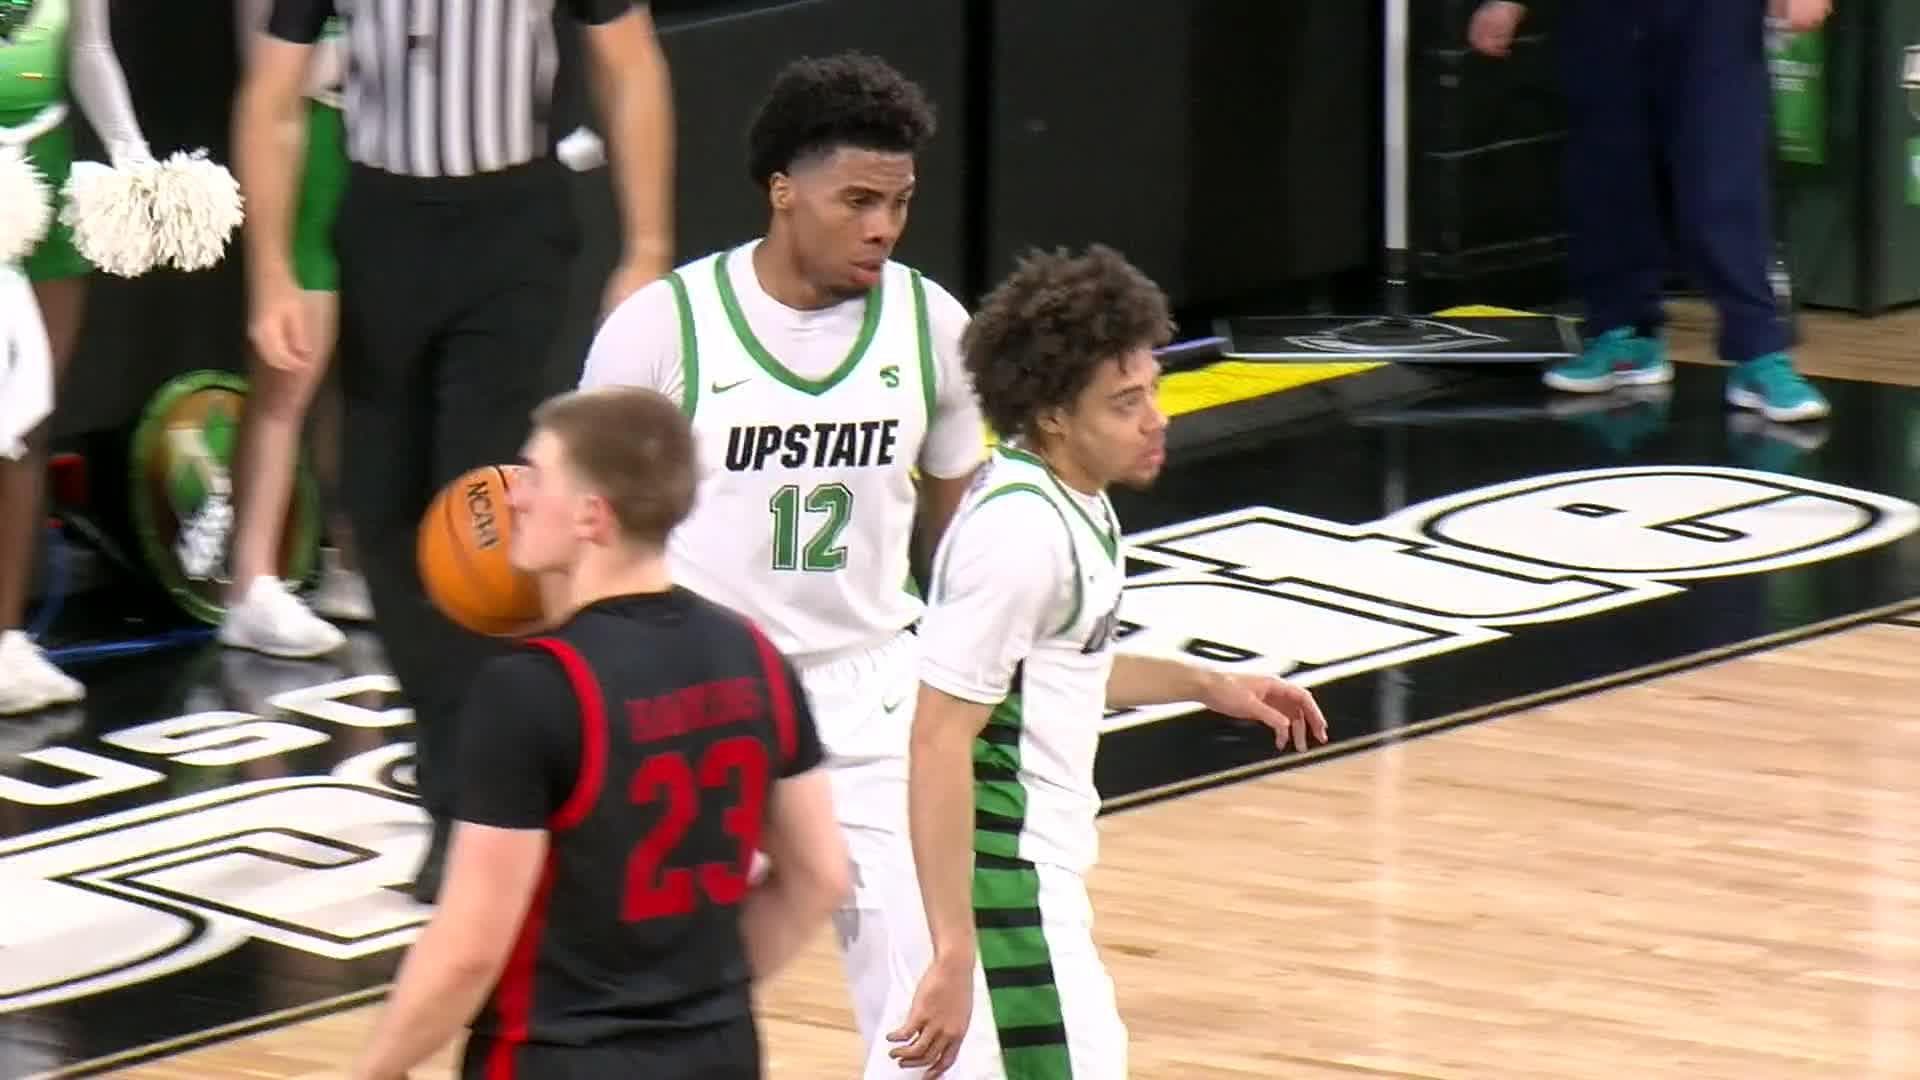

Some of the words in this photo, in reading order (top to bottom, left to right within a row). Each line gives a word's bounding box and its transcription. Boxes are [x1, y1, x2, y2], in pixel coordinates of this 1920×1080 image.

[724, 418, 900, 472] UPSTATE
[466, 480, 502, 551] NCAA
[769, 482, 854, 572] 12
[617, 734, 769, 923] 23
